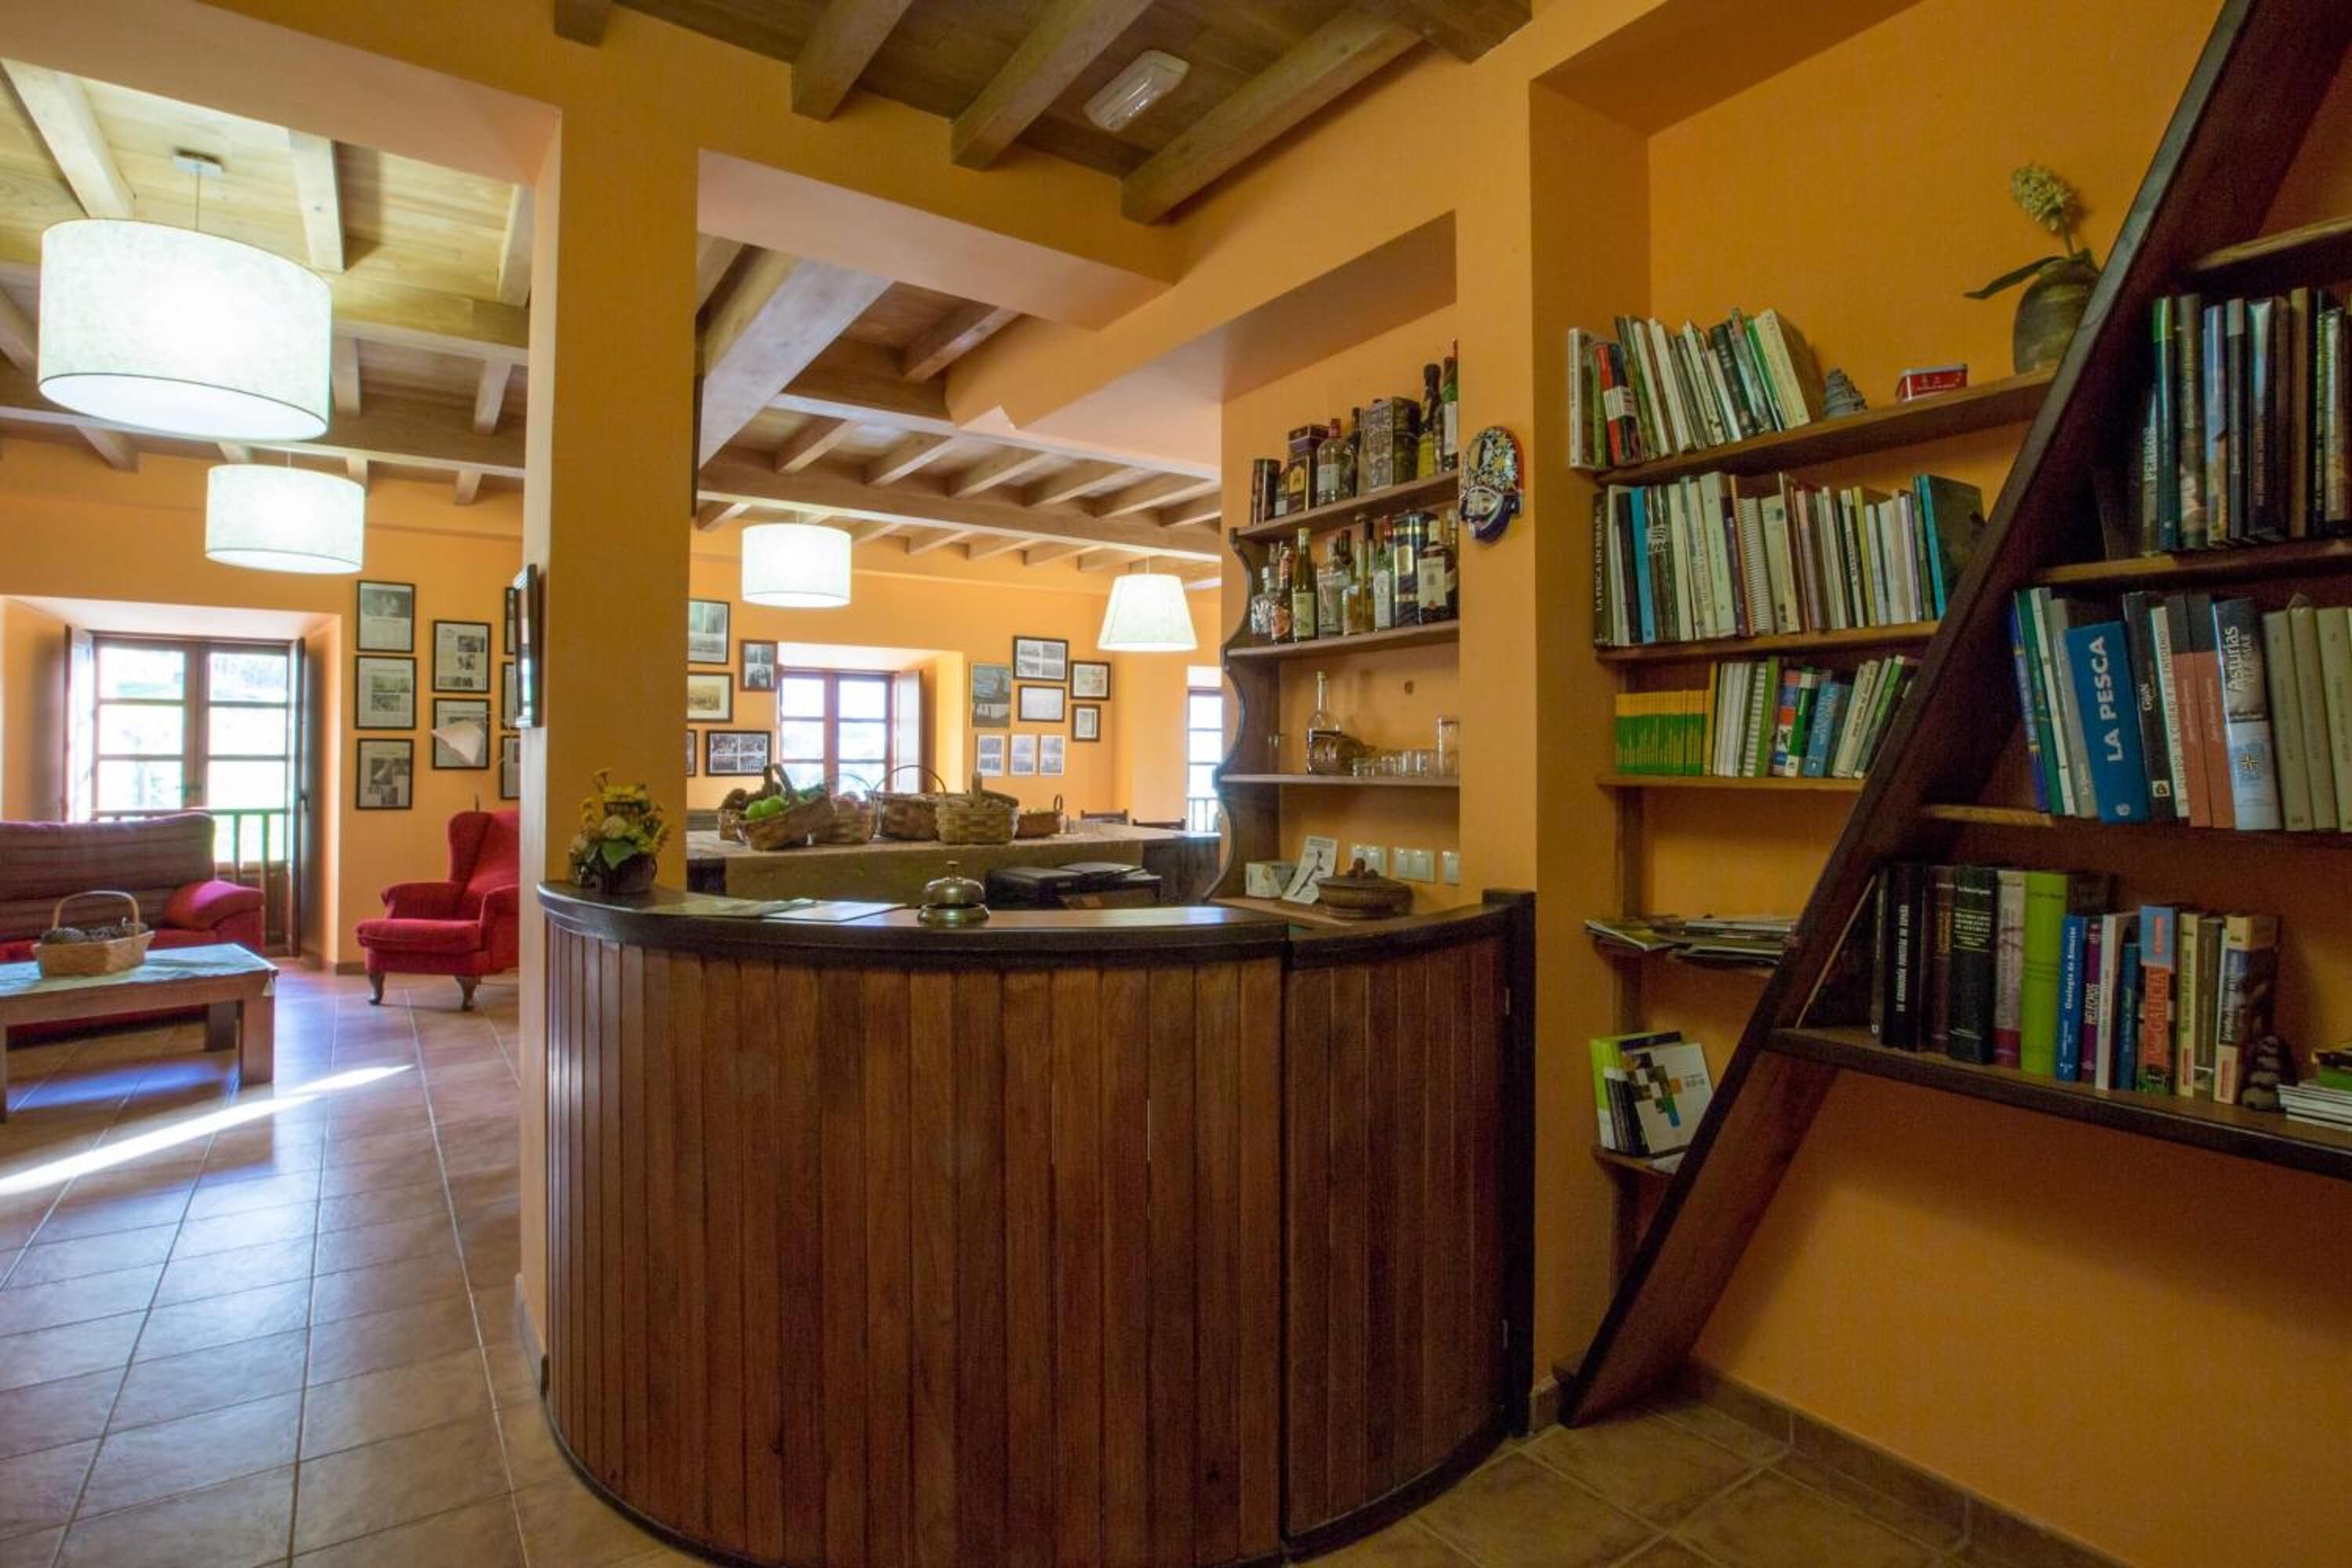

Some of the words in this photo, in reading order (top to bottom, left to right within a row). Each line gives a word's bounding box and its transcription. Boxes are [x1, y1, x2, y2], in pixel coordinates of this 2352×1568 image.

[1595, 552, 1603, 564] EN
[1595, 565, 1603, 596] PESCA
[1595, 597, 1603, 612] LA
[2224, 626, 2242, 691] Asturias
[2089, 636, 2117, 721] PESCA
[2104, 728, 2123, 761] LA
[2067, 927, 2077, 960] Asturias
[2151, 972, 2166, 1032] GALICIA
